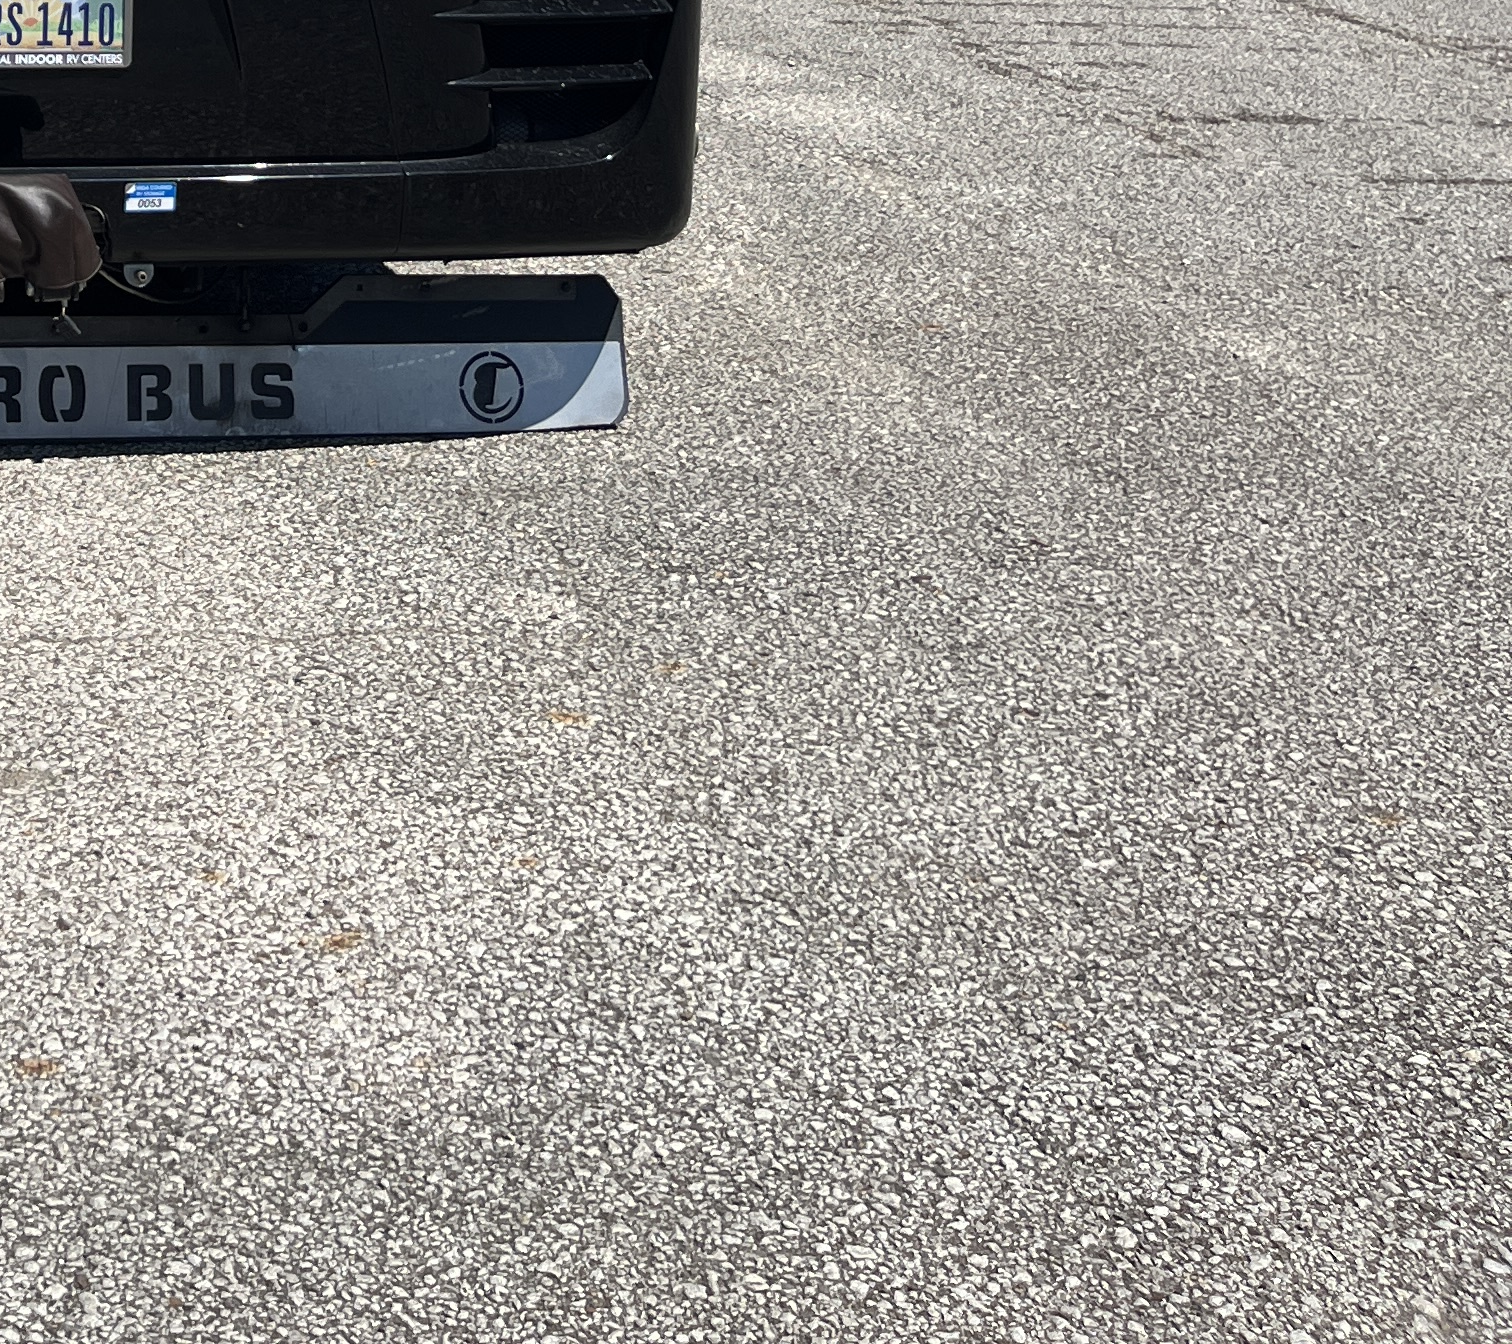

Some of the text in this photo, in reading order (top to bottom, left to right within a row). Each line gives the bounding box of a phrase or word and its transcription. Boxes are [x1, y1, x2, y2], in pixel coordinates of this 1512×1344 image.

[36, 1, 115, 47] 1410
[14, 53, 64, 65] INDOOR
[66, 53, 80, 65] RV
[81, 53, 123, 65] CENTERS
[138, 198, 162, 208] 0053
[125, 362, 296, 423] BUS
